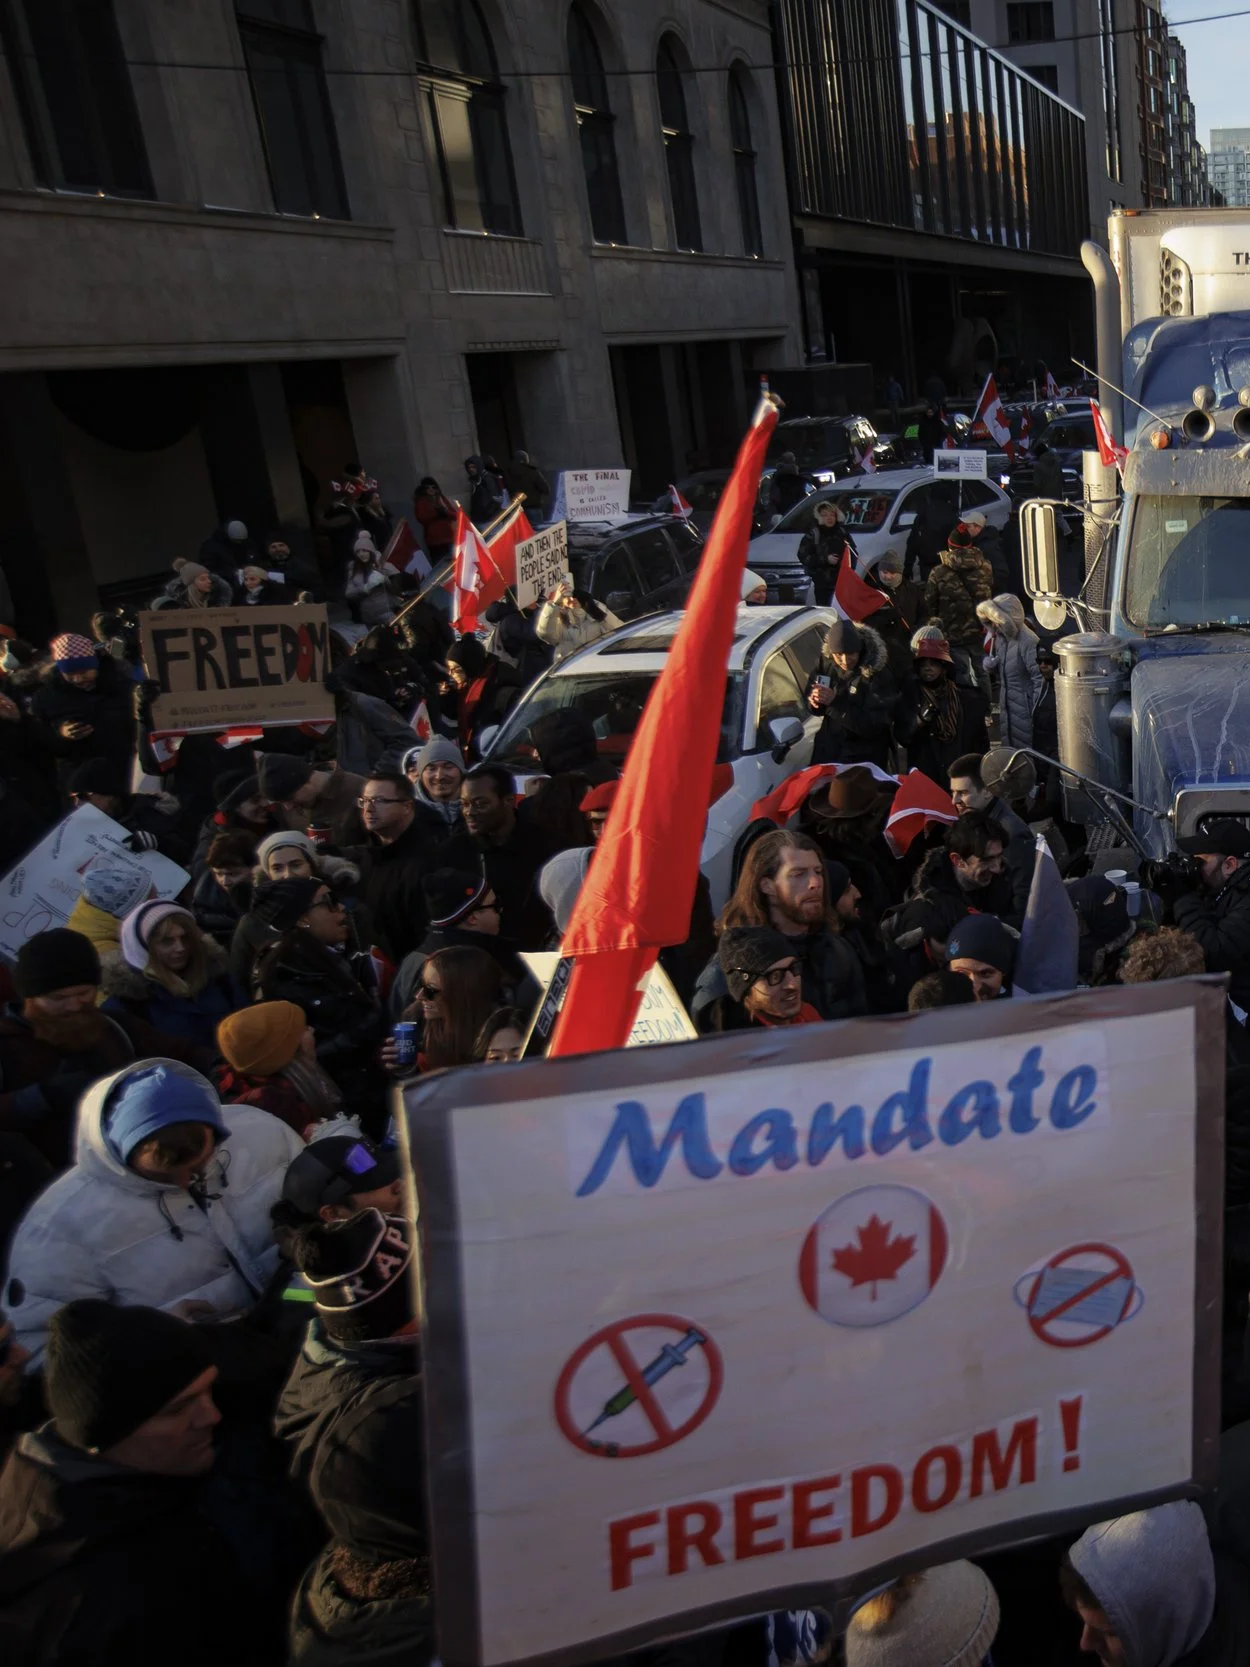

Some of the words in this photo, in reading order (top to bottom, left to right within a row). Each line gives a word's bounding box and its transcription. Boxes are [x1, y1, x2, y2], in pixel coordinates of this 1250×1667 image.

[520, 543, 535, 564] AND
[535, 534, 551, 555] THEN
[552, 528, 564, 547] THE
[520, 556, 545, 583] PEOPLE
[545, 548, 560, 569] SAID
[532, 575, 546, 596] THE
[152, 622, 328, 693] FREEDOM
[576, 1046, 1098, 1197] Mandate
